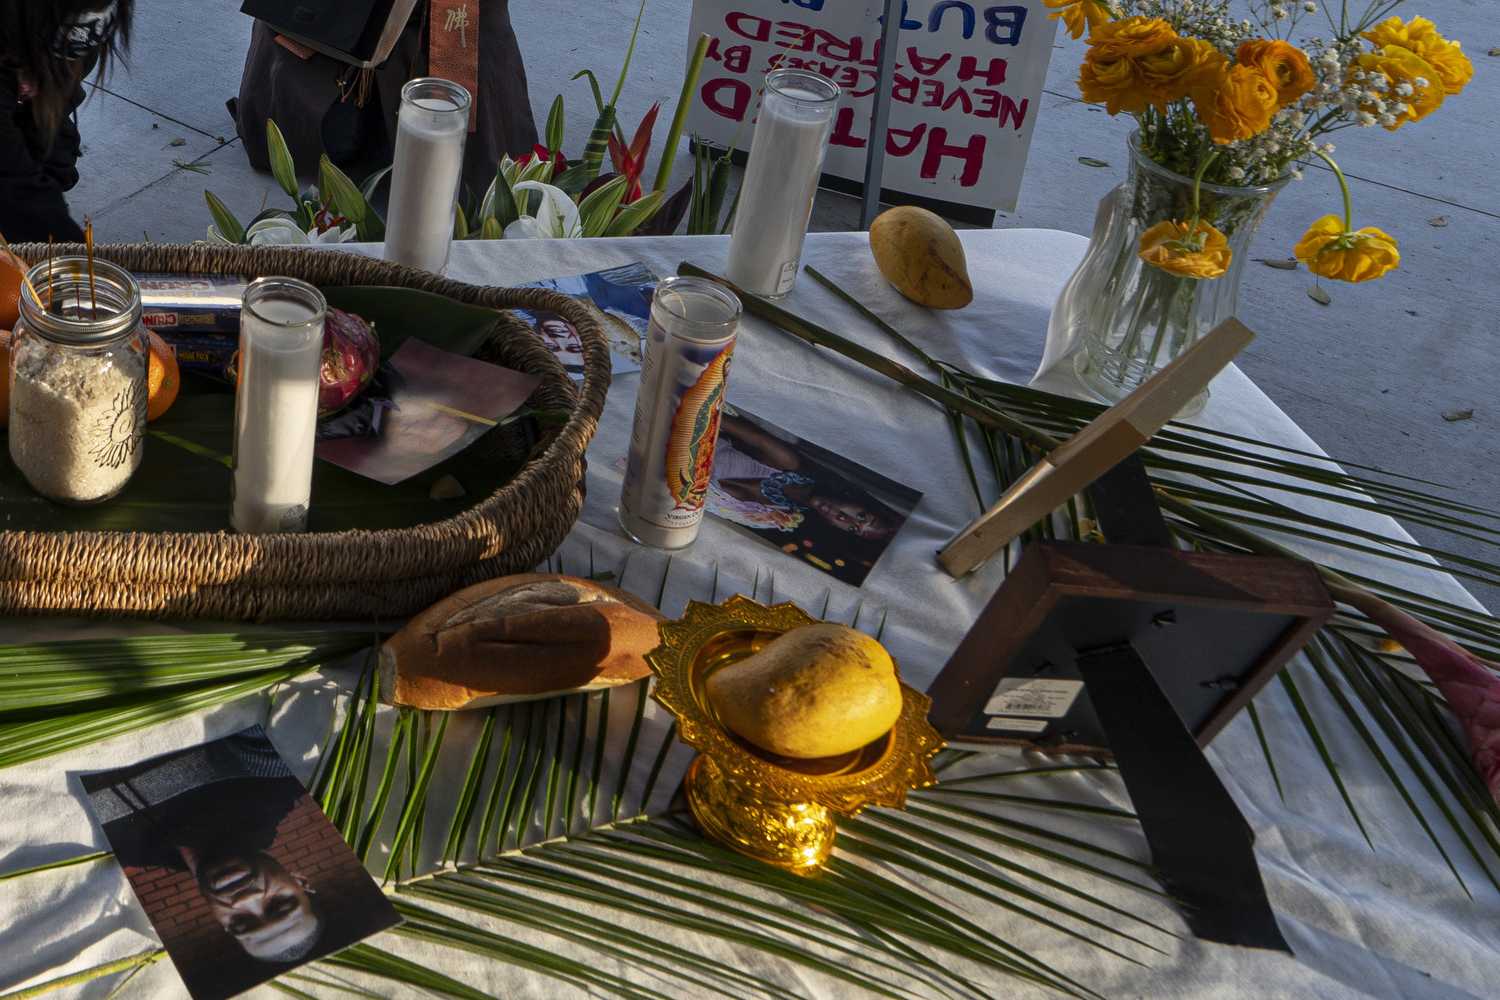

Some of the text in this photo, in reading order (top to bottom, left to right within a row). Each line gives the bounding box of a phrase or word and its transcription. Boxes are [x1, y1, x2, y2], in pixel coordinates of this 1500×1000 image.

[703, 37, 752, 74] BY
[724, 10, 1008, 87] HATRED
[700, 77, 987, 188] HATD
[891, 72, 1029, 131] NEVER
